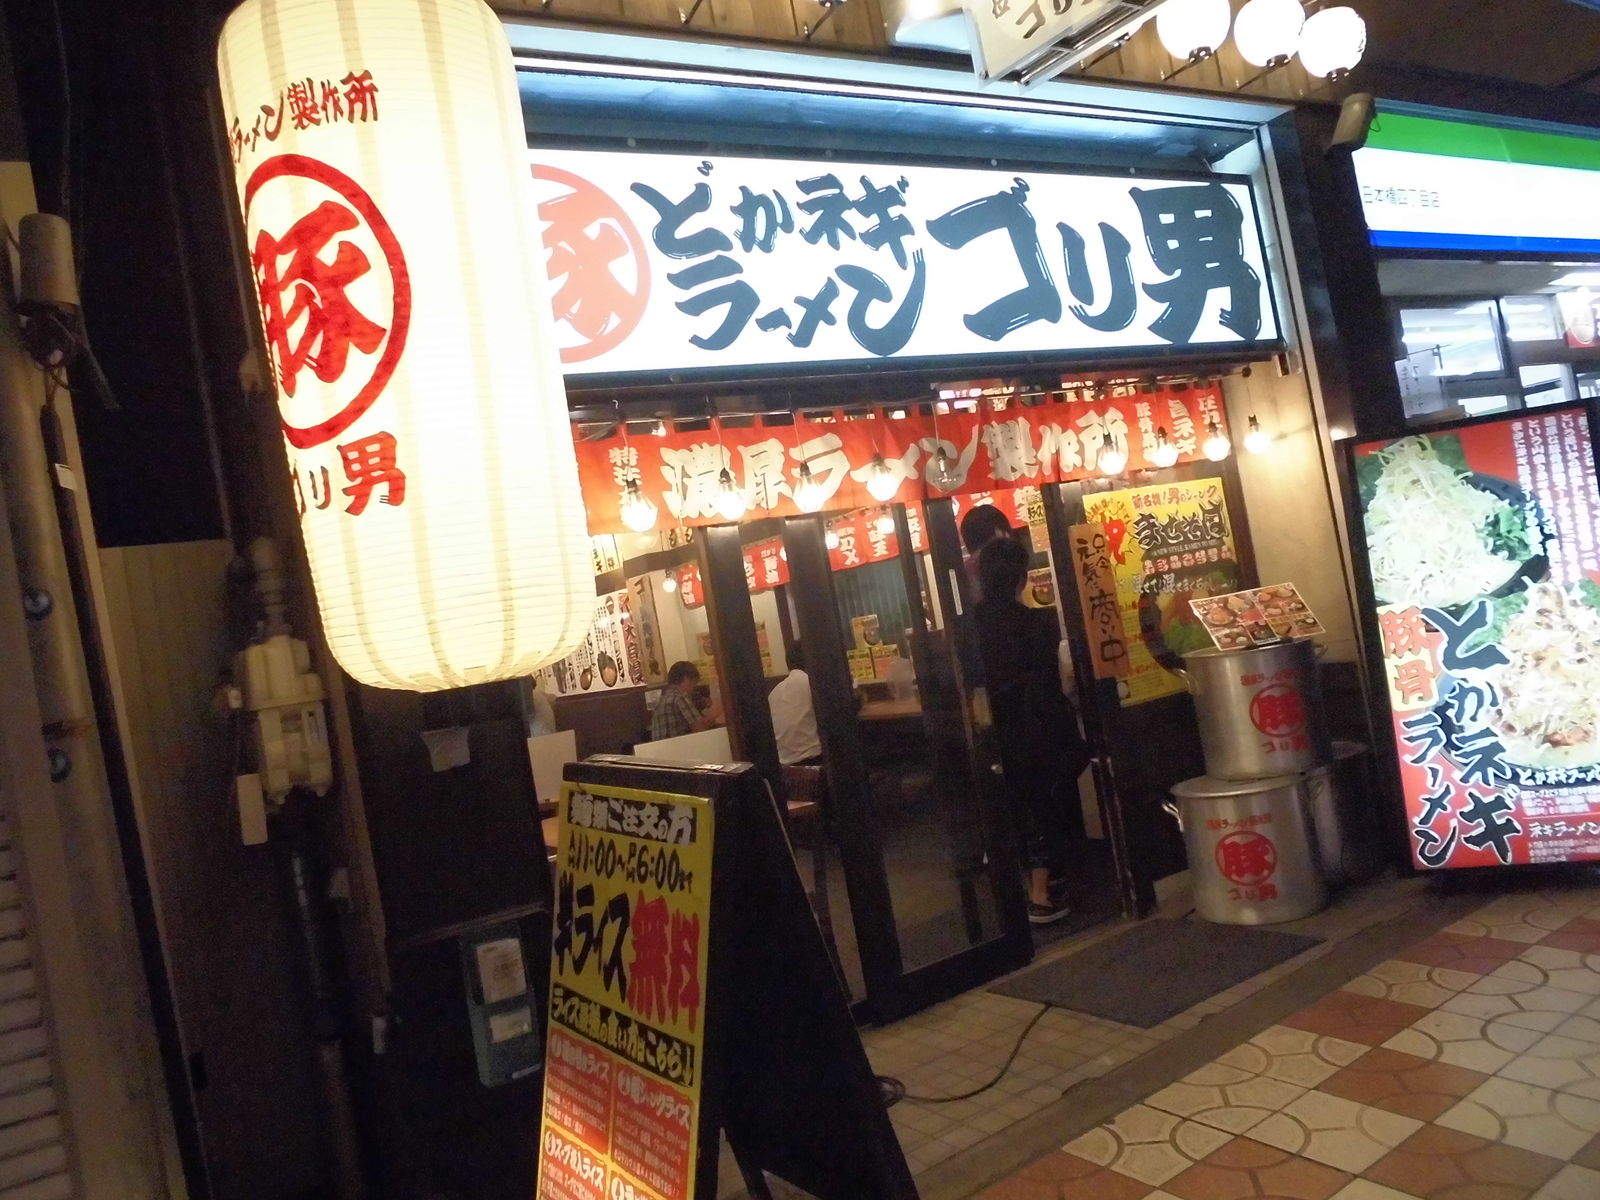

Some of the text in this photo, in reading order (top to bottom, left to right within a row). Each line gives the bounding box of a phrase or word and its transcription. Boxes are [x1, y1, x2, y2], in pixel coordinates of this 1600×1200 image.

[630, 160, 916, 269] どかネギ
[925, 177, 1262, 344] ゴリ男
[667, 248, 927, 358] ラーメン
[290, 431, 406, 525] リ男
[661, 406, 1129, 521] 濃厚ラーメン製作所
[1133, 501, 1229, 549] まぜそば
[1089, 588, 1127, 665] 商い中
[1380, 606, 1436, 705] 豚骨
[1402, 713, 1457, 867] ラーメン
